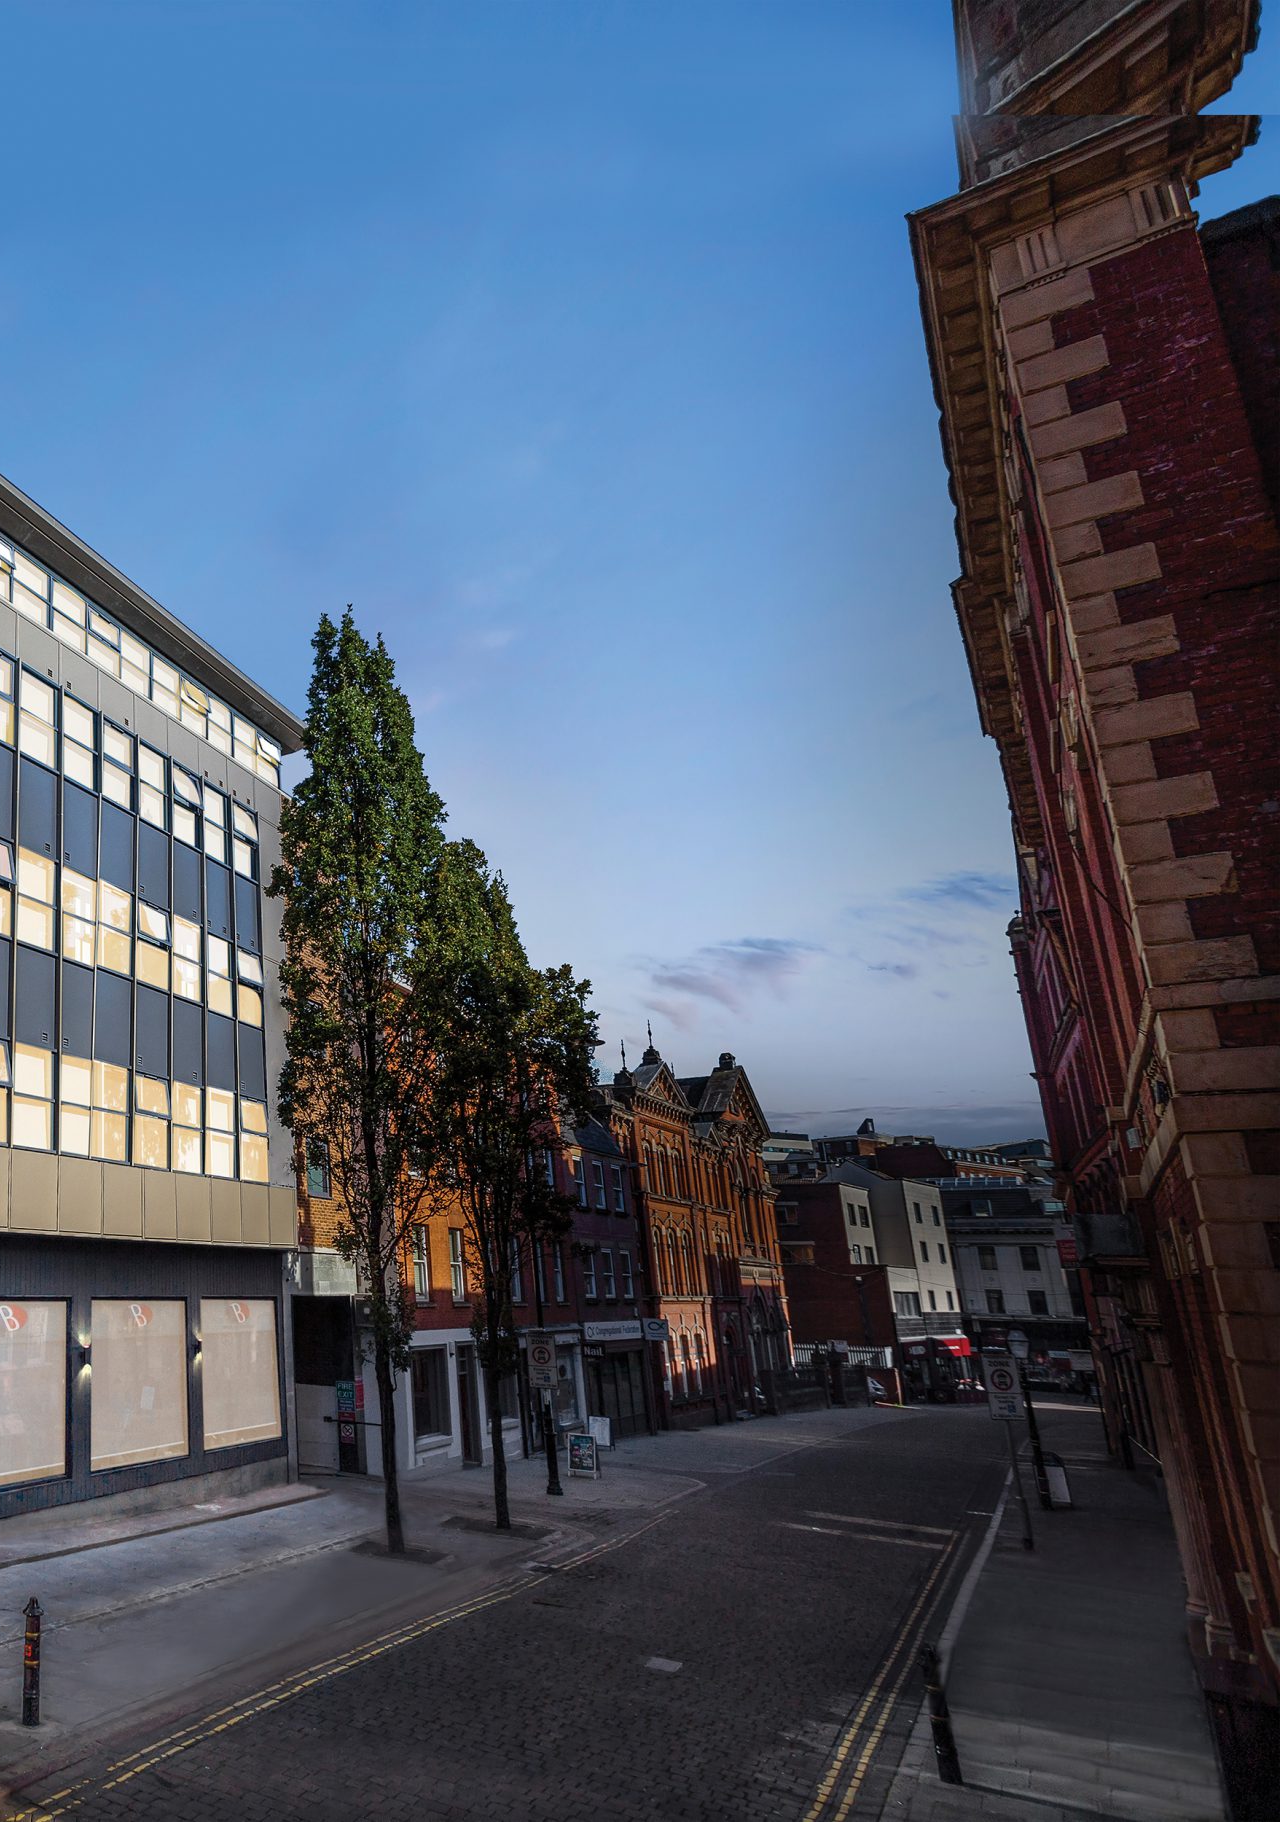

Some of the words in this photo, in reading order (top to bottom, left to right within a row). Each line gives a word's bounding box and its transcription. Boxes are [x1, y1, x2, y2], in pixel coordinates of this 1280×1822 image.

[129, 1303, 147, 1328] B
[229, 1303, 246, 1324] B
[987, 1360, 1010, 1368] ZONE
[337, 1382, 353, 1390] FIRE
[337, 1390, 353, 1398] EXIT
